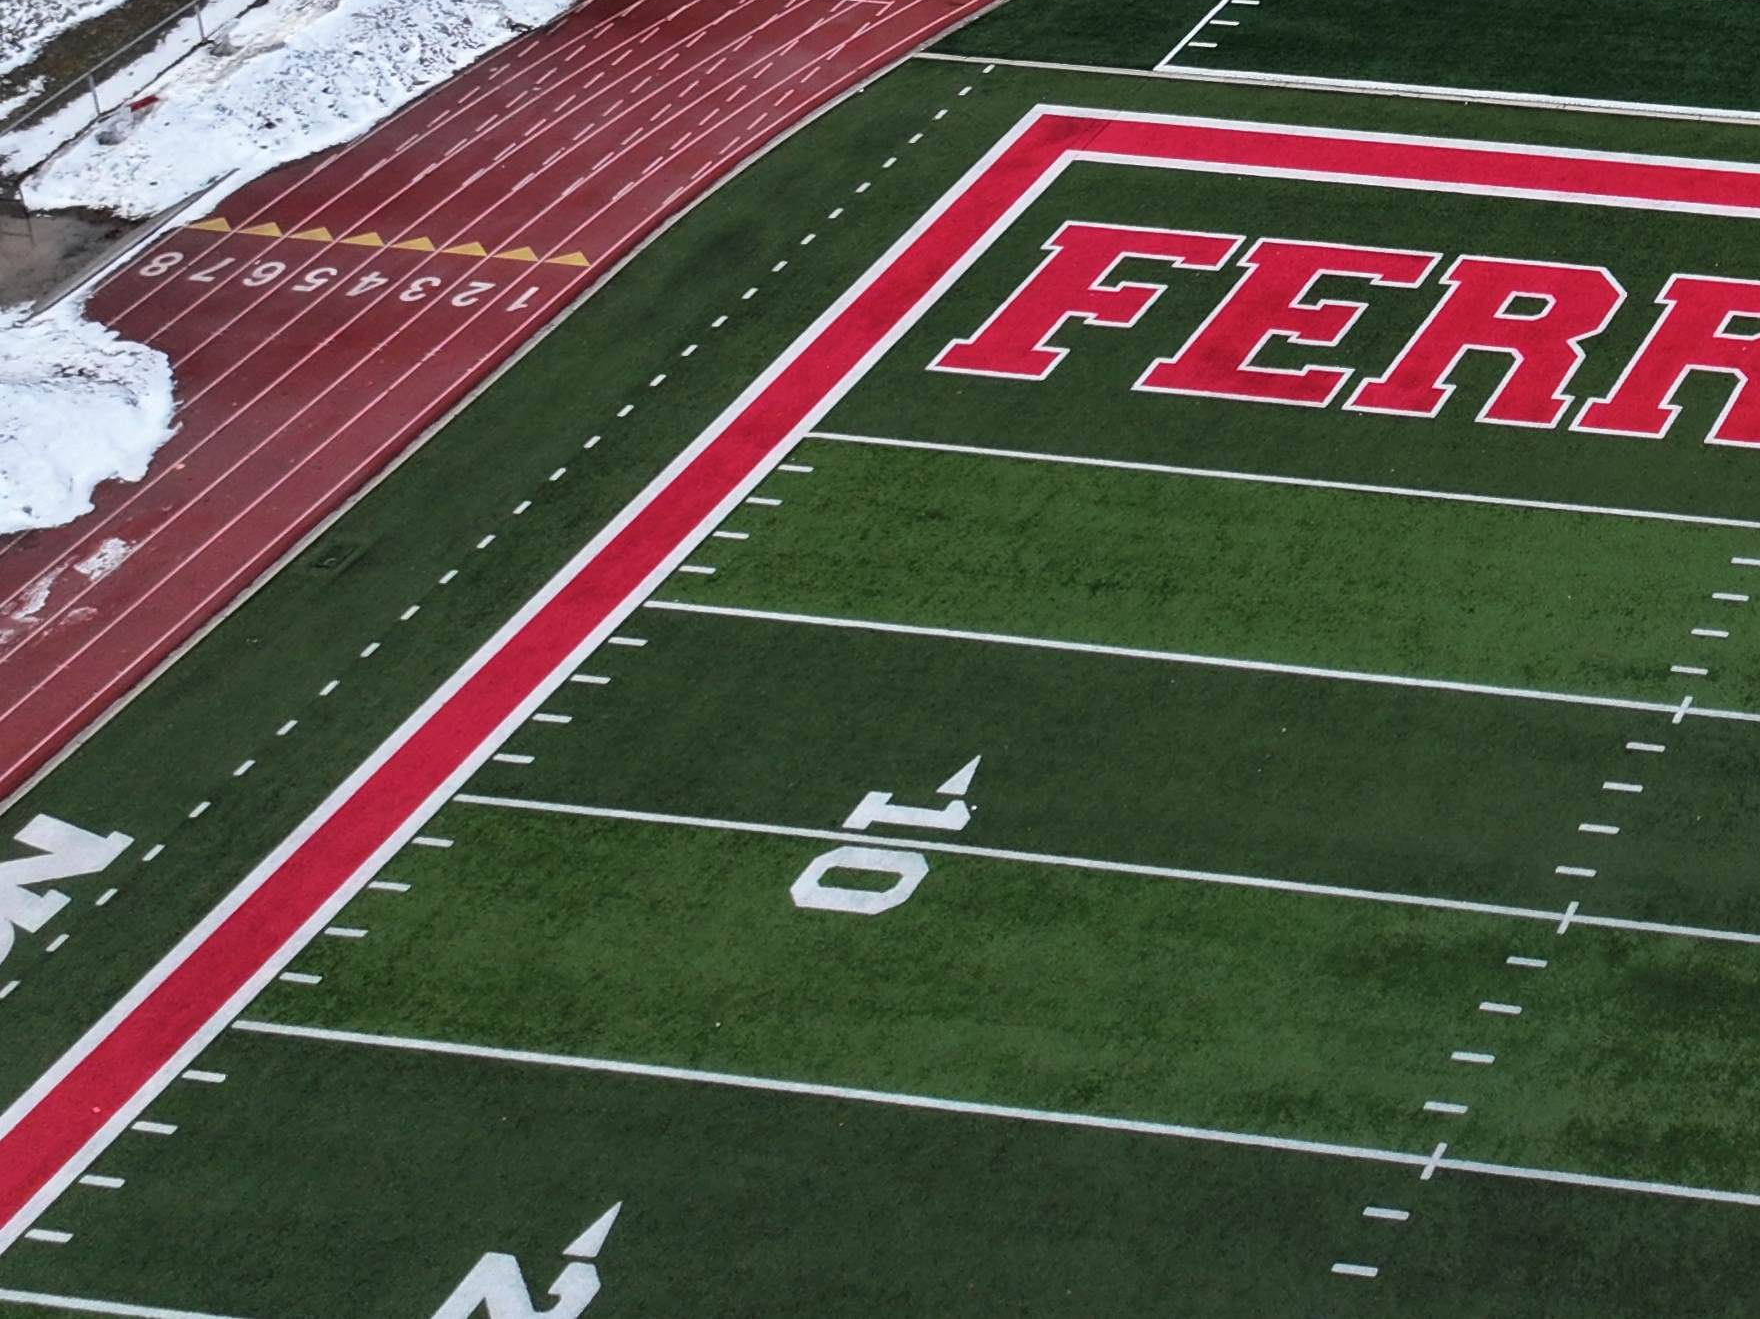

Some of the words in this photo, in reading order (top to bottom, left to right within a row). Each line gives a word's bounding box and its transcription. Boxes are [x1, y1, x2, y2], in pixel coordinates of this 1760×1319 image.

[139, 252, 184, 277] 8
[188, 257, 235, 282] 7
[242, 261, 287, 287] 6
[292, 267, 338, 292] 5
[345, 271, 389, 297] 4
[398, 276, 442, 302] 3
[450, 281, 497, 307] 2
[505, 285, 540, 312] 1
[790, 791, 970, 915] 10
